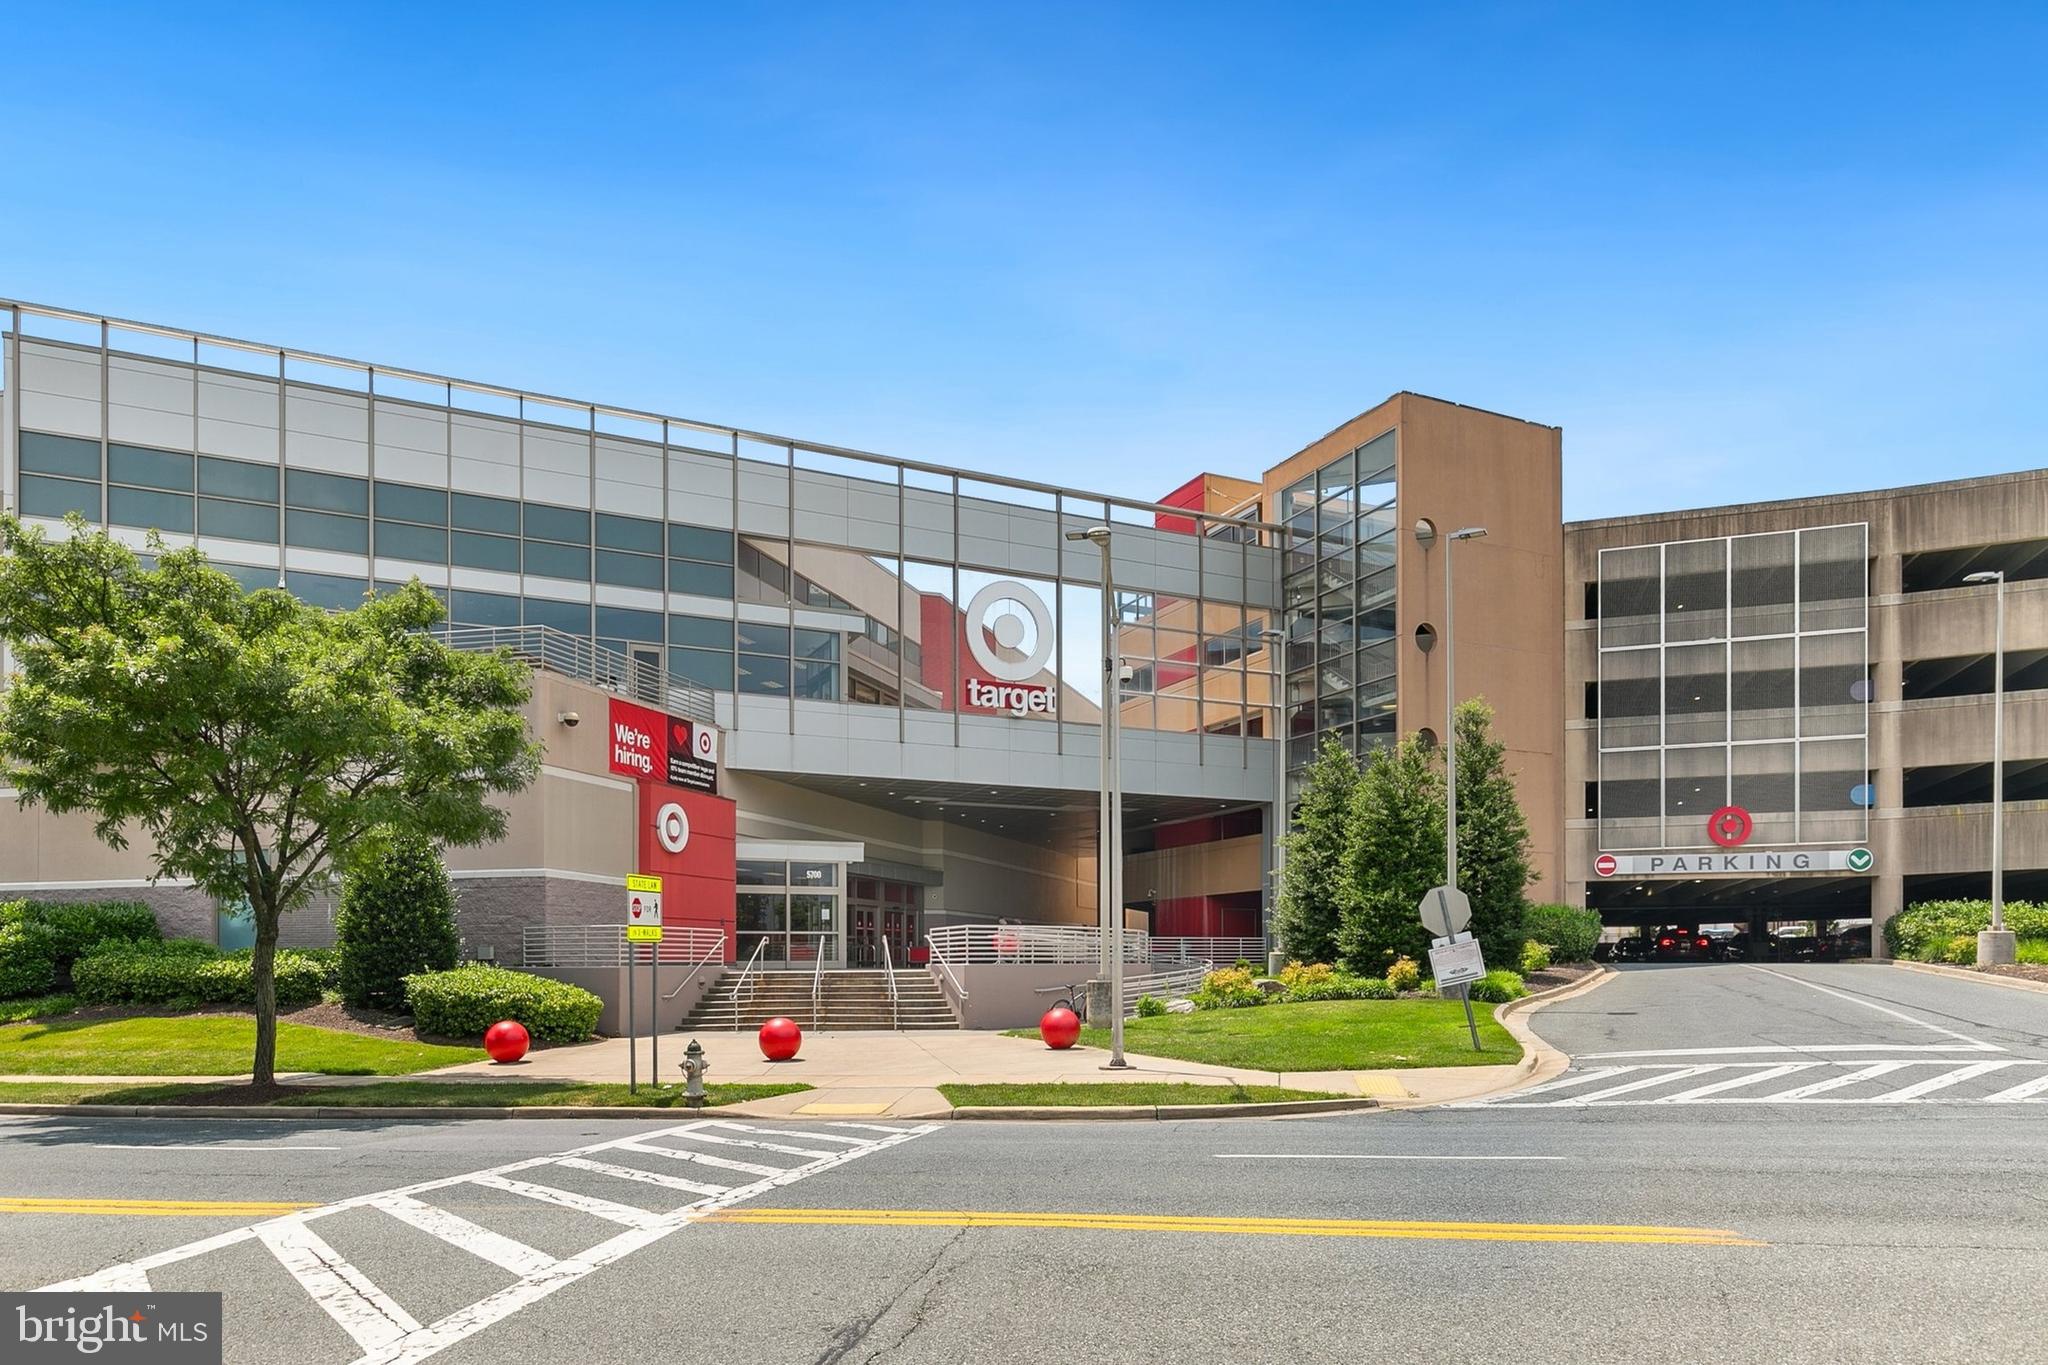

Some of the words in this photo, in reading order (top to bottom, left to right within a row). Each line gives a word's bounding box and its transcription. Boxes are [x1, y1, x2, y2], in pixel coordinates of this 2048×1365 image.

[967, 678, 1056, 717] target
[614, 722, 651, 750] We're
[615, 743, 653, 774] hiring.
[1650, 853, 1810, 872] PARKING
[632, 878, 647, 889] STATE
[647, 880, 658, 890] LAW
